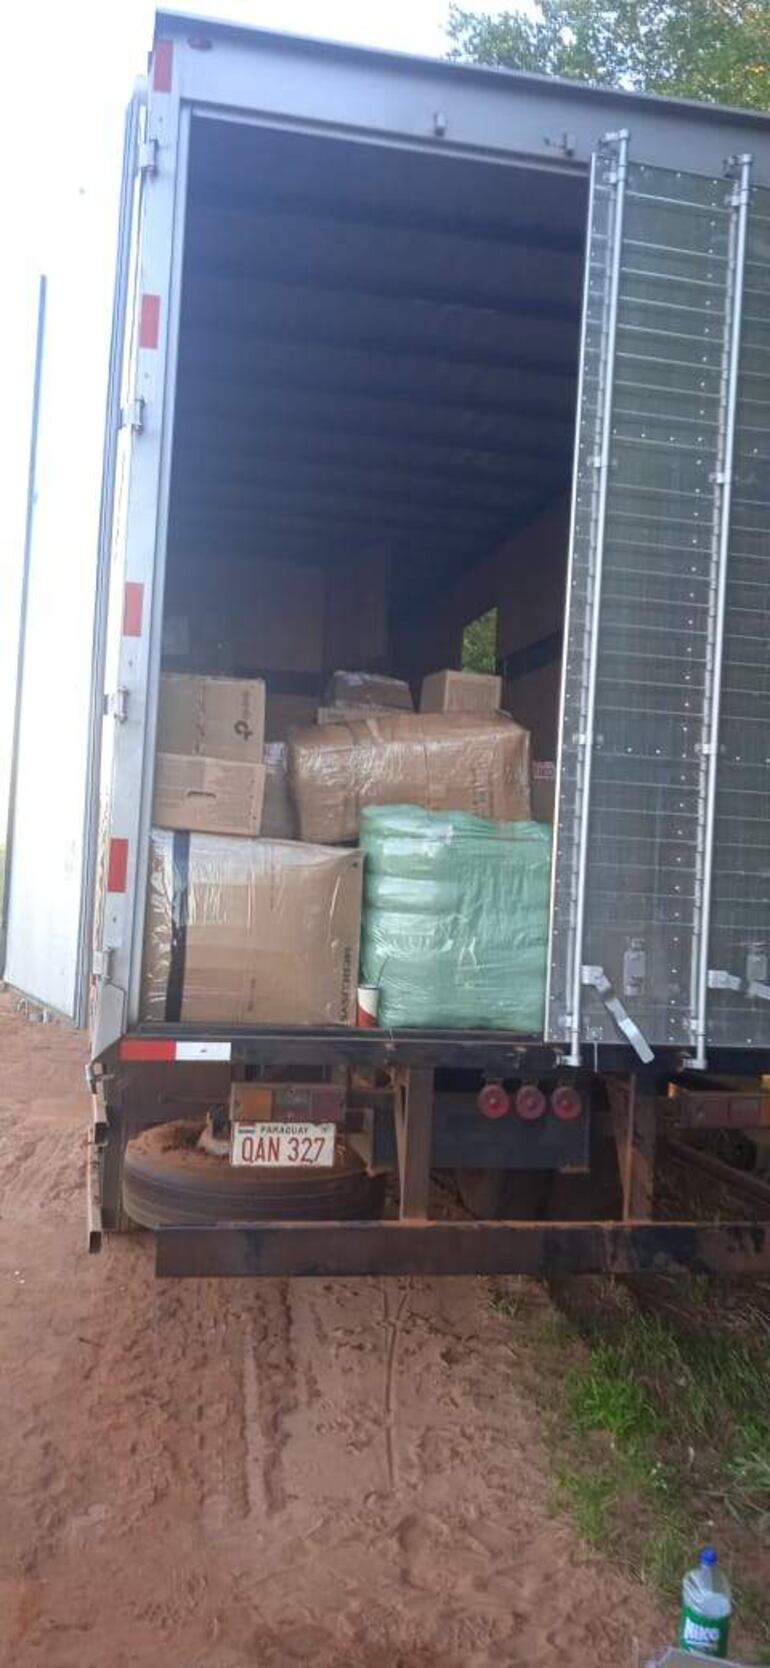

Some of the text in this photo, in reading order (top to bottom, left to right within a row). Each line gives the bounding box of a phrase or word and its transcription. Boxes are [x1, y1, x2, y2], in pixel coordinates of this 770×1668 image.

[260, 1125, 308, 1135] PARAGUAY
[241, 1136, 325, 1163] QAN 327
